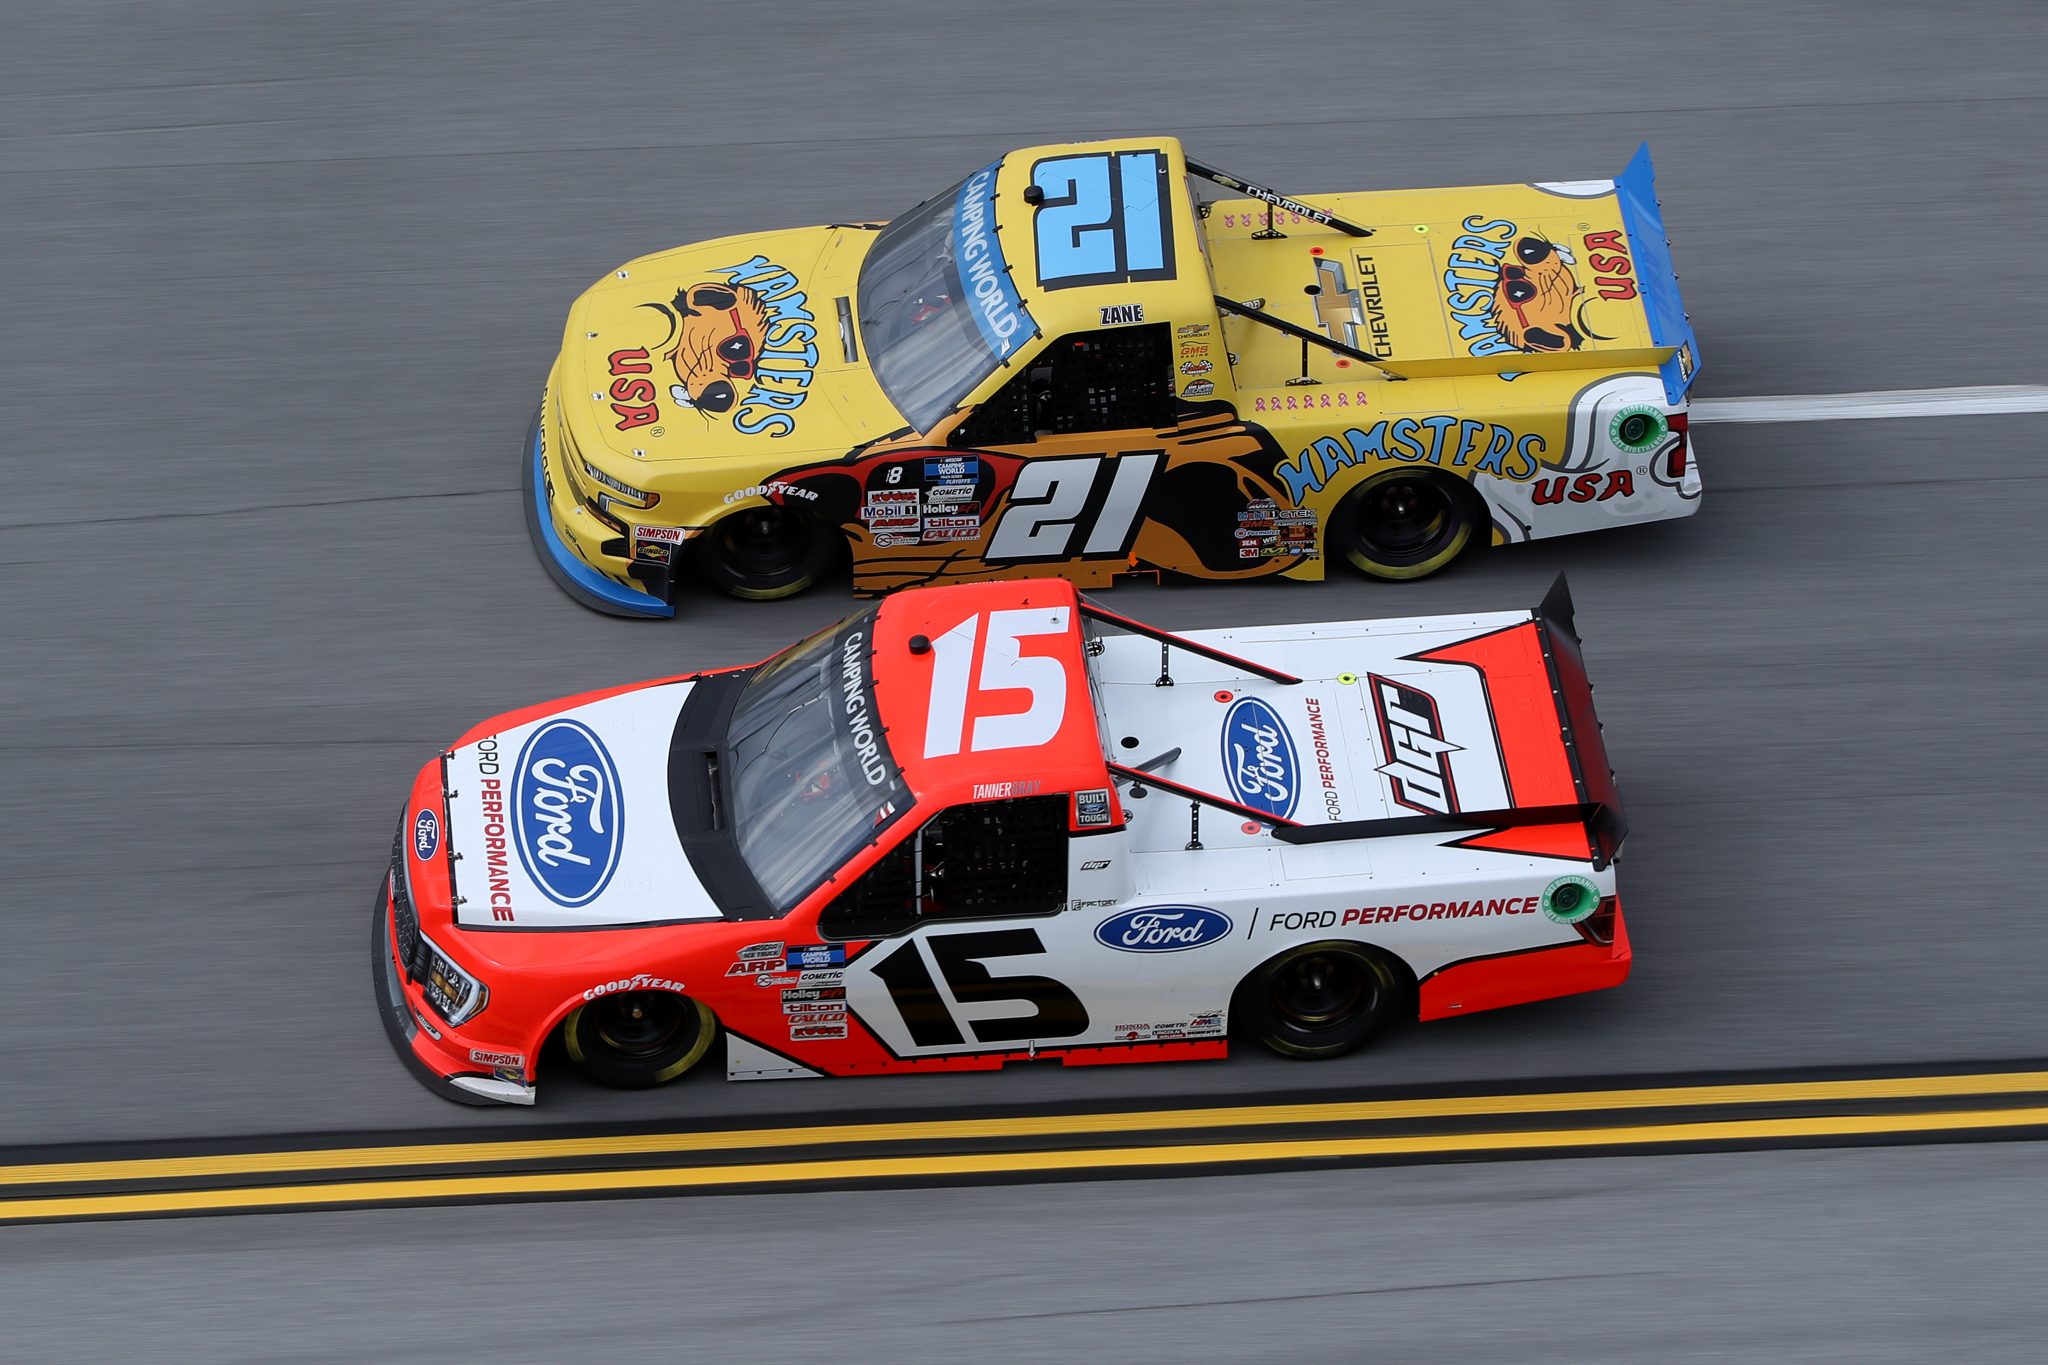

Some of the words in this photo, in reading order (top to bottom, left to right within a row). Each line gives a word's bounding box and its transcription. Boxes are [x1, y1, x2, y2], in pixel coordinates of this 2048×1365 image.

[961, 171, 990, 262] CAMPING
[1031, 152, 1164, 284] 21
[1246, 185, 1333, 225] CHEVROLET
[1583, 229, 1638, 302] USA
[968, 259, 1019, 339] WORLD
[1356, 254, 1393, 358] CHEVROLET
[1443, 214, 1521, 382] AMSTERS
[1100, 305, 1144, 325] ZANE
[704, 254, 820, 439] HAMSTERS
[1180, 346, 1209, 355] GMS
[607, 345, 660, 432] USA
[937, 462, 965, 470] CAMPING
[938, 467, 965, 475] WORLD
[1274, 415, 1547, 508] HAMSTERS
[723, 480, 819, 506] GOODYEAR
[1531, 468, 1635, 506] USA
[863, 507, 901, 517] Mobil
[922, 504, 959, 515] Holley
[927, 518, 977, 527] tilton
[984, 454, 1159, 560] 21
[636, 527, 682, 541] SIMPSON
[923, 528, 980, 539] CALICO
[638, 547, 669, 556] SUNOCO
[1240, 548, 1258, 558] 3M
[842, 631, 866, 715] CAMPING
[922, 605, 1071, 760] 15
[848, 709, 887, 786] WORLD
[1305, 697, 1335, 790] PERFORMANCE
[1078, 793, 1106, 804] BUILT
[1327, 791, 1344, 822] FORD
[1079, 813, 1108, 823] TOUGH
[480, 778, 515, 922] PERFORMANCE
[1121, 912, 1205, 945] Ford
[1269, 910, 1337, 931] FORD
[1340, 896, 1540, 927] PERFORMANCE
[728, 960, 785, 974] ARP
[802, 956, 831, 964] WORLD
[582, 972, 688, 1001] GOODYEAR
[782, 990, 820, 1000] Holley
[869, 927, 1090, 1048] 15
[786, 1003, 843, 1013] tilton
[473, 1052, 520, 1066] SIMPSON
